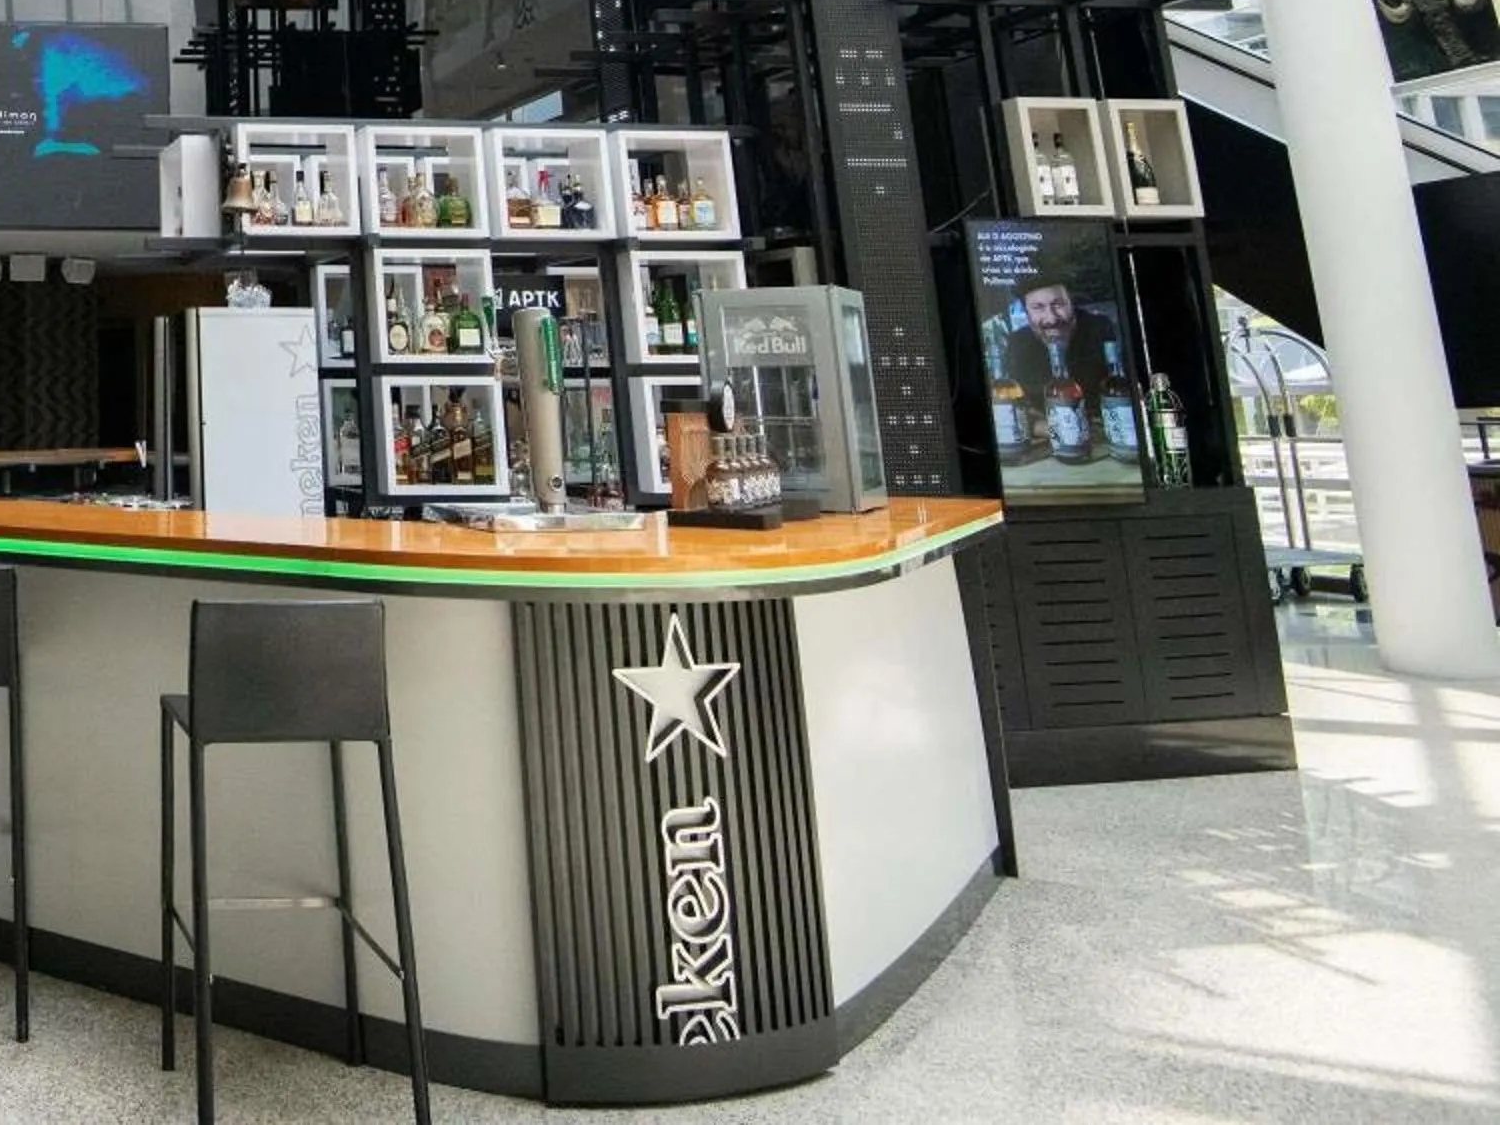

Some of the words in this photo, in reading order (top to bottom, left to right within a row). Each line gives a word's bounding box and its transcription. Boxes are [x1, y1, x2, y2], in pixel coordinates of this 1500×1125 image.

[509, 289, 560, 308] APTK
[733, 334, 769, 355] Red
[771, 335, 806, 355] Bull
